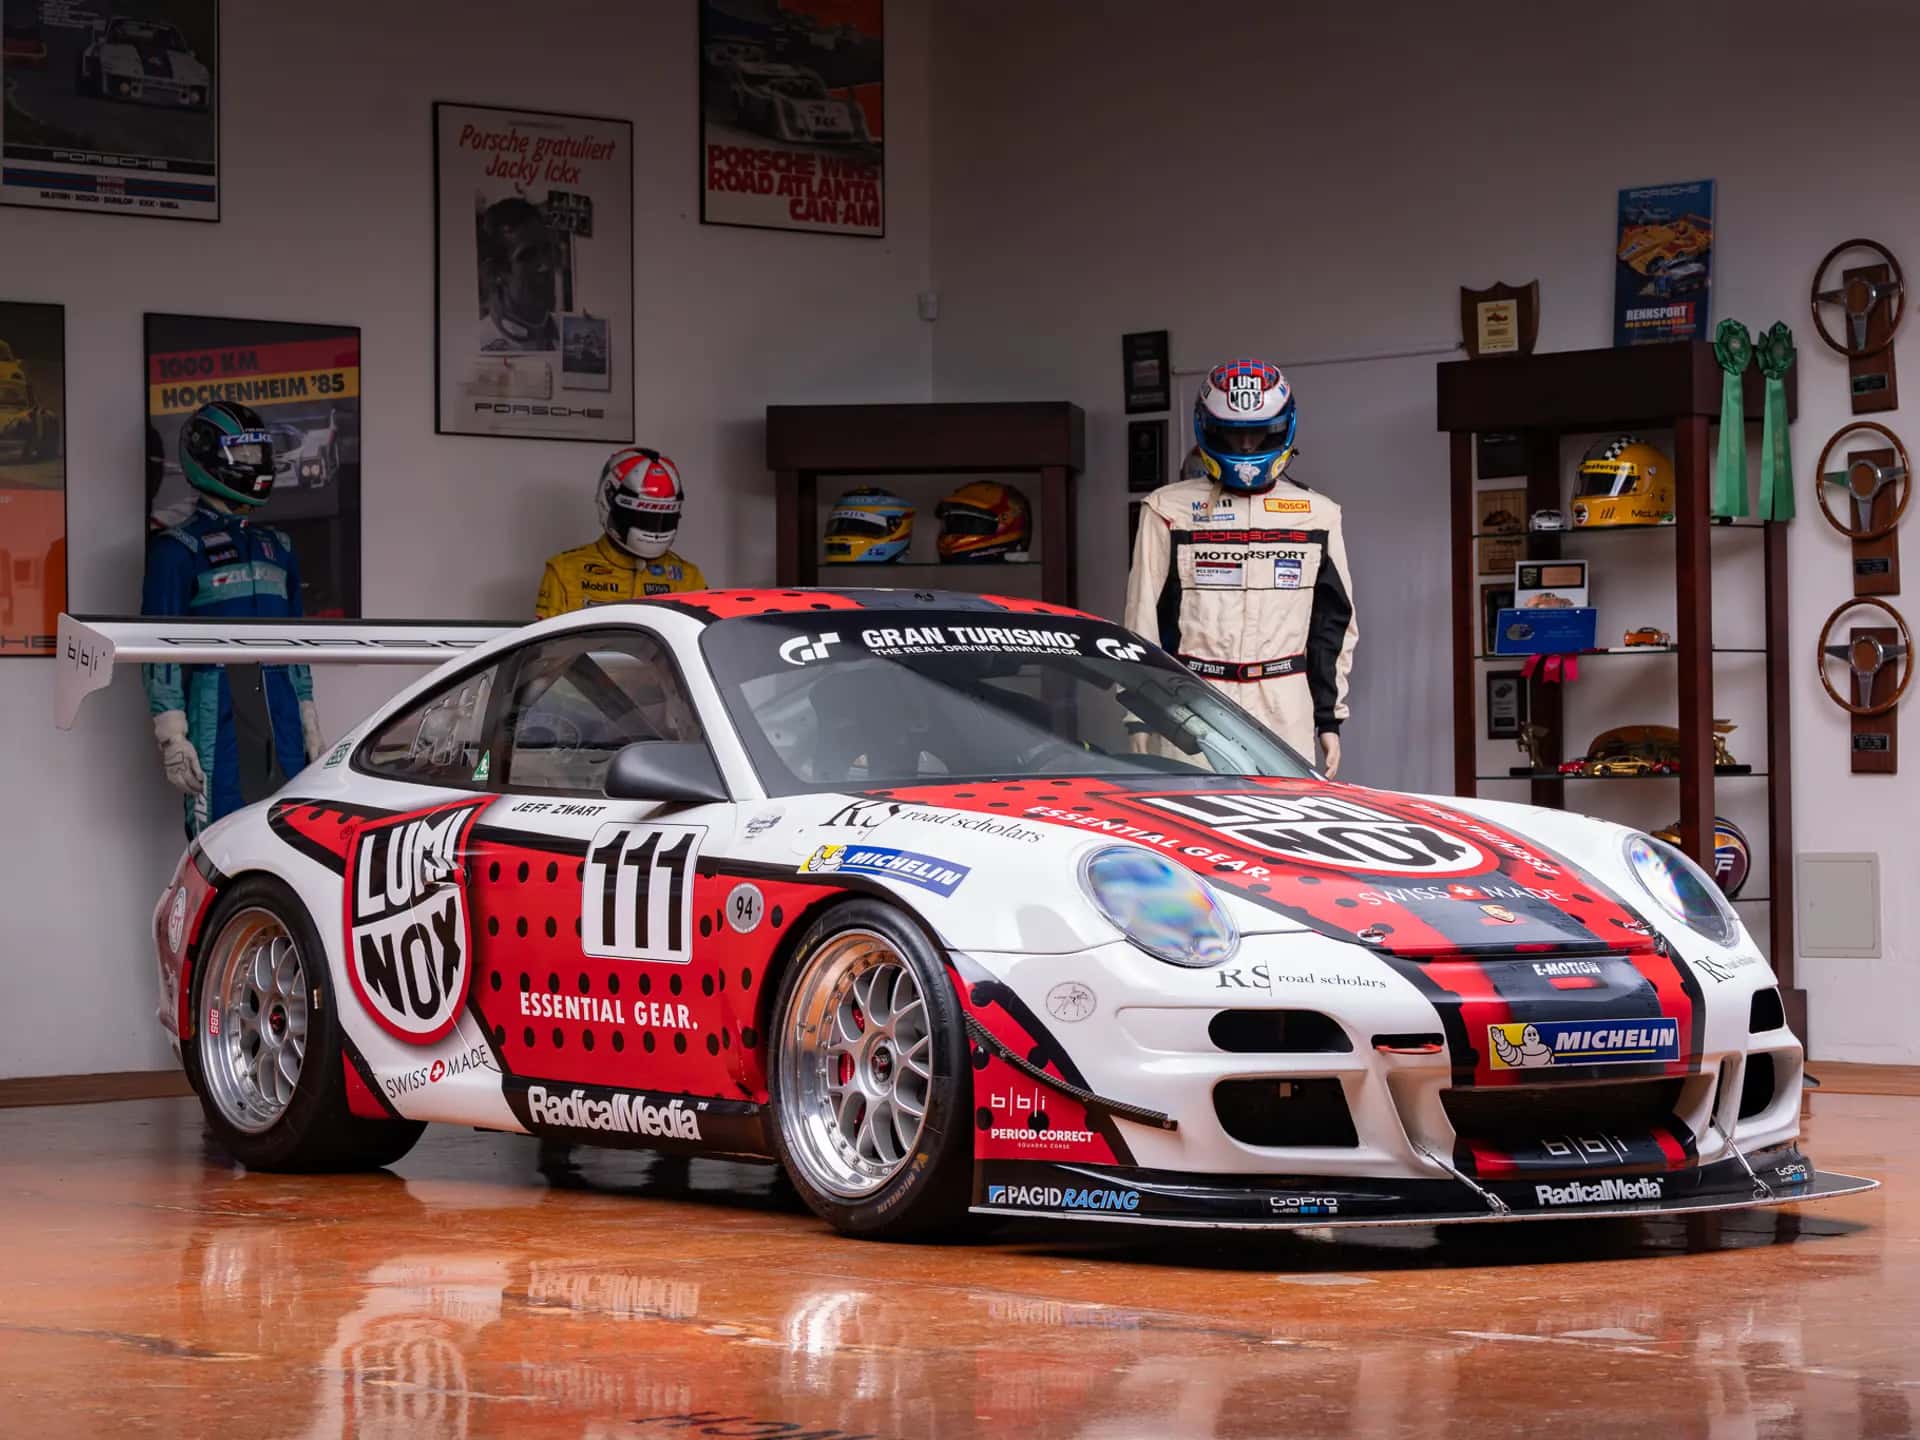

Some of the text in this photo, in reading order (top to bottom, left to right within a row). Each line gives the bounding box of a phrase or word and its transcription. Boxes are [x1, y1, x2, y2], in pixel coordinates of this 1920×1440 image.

[459, 124, 616, 163] Porsche gratuliert
[52, 151, 169, 170] PORSCHE
[485, 154, 581, 186] Jacky Ickx
[708, 145, 815, 176] PORSCHE
[708, 168, 880, 204] ROAD ATLANTA
[158, 351, 260, 378] 1000 KM
[162, 377, 308, 408] HOCKENHEIM
[1229, 375, 1261, 390] LUMI
[474, 403, 605, 419] PORSCHE
[1229, 391, 1261, 410] NOX
[1278, 502, 1308, 511] BOSCH
[1193, 531, 1308, 542] PORSCHE
[1194, 550, 1308, 560] MOTORSPORT
[581, 581, 608, 592] Mobil
[862, 627, 946, 648] GRAN
[871, 644, 1083, 656] THE REAL DRIVING SIMULATOR
[512, 802, 607, 817] JEFF ZWART
[1148, 796, 1405, 825] LUMI
[901, 809, 954, 825] road
[952, 816, 1046, 844] scholars
[1024, 805, 1272, 881] ESSENTIAL GEAR.
[1236, 824, 1467, 868] NOX
[357, 807, 475, 918] LUMI
[846, 851, 962, 886] MICHELIN
[592, 830, 697, 952] 111
[1359, 884, 1569, 906] SWISS MADE
[735, 895, 754, 920] 94
[359, 896, 461, 1020] NOX
[1532, 962, 1601, 976] E-MOTION
[1216, 964, 1387, 989] RS road scholars
[209, 1009, 220, 1034] BBS
[520, 991, 699, 1031] ESSENTIAL GEAR.
[1554, 1027, 1676, 1051] MICHELIN
[386, 1044, 490, 1100] SWISS MADE
[991, 1128, 1094, 1142] PERIOD CORRECT
[1774, 1164, 1806, 1176] GoPro
[1269, 1196, 1337, 1207] GoPro
